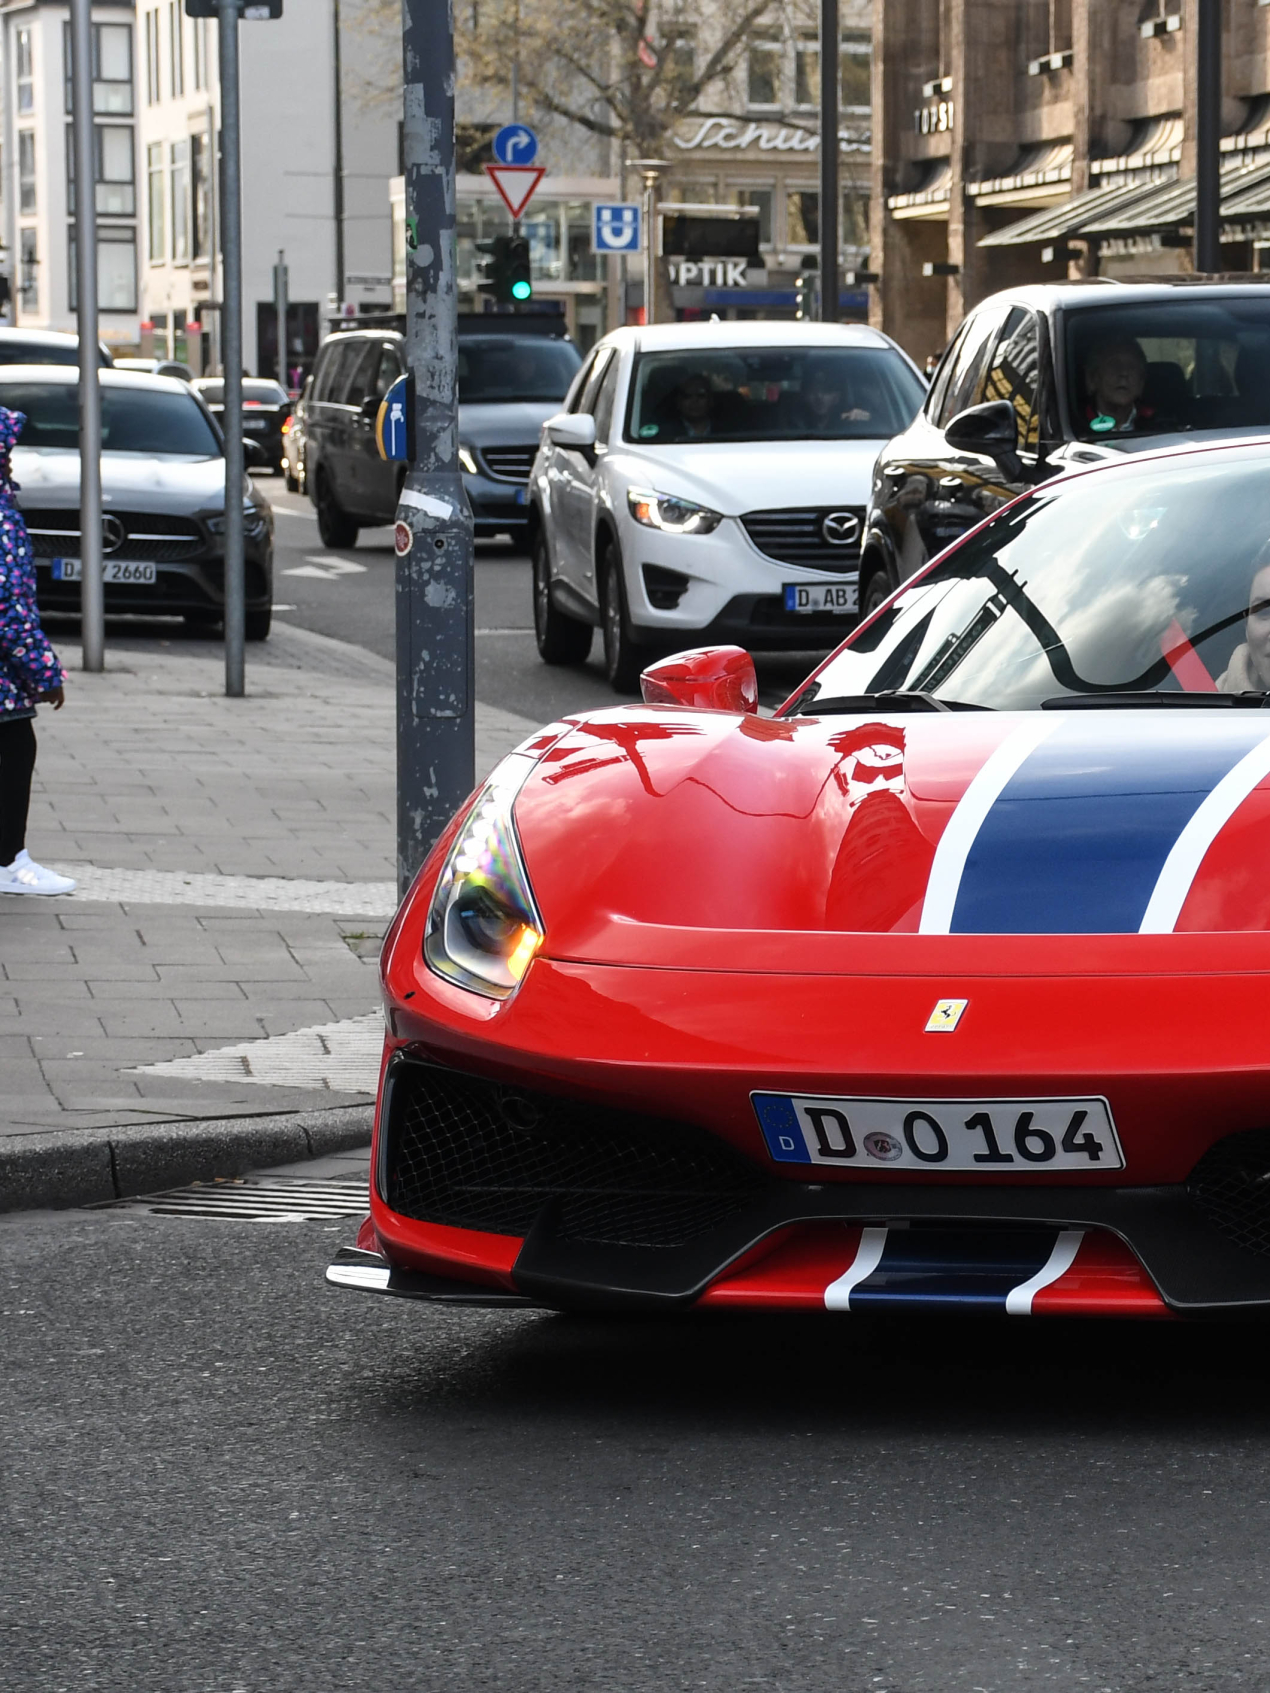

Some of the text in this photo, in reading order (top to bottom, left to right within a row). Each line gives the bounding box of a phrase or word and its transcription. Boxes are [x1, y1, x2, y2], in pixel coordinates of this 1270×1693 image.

[64, 563, 74, 578] D
[112, 564, 153, 580] 2660
[798, 589, 809, 605] D
[824, 589, 848, 605] AB
[803, 1107, 857, 1158] D
[964, 1110, 1103, 1163] 164
